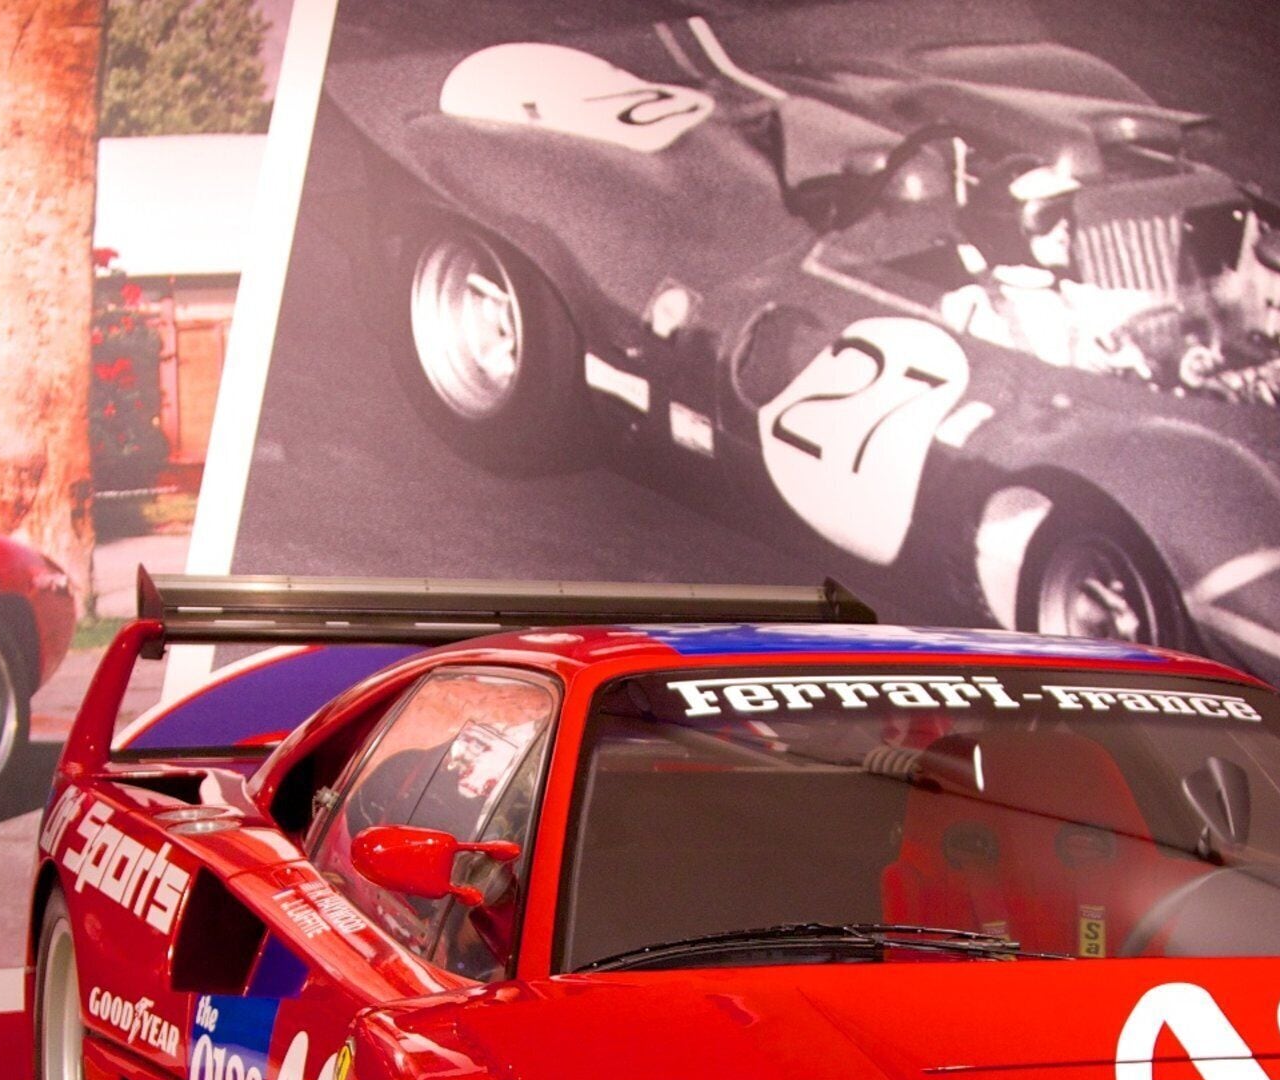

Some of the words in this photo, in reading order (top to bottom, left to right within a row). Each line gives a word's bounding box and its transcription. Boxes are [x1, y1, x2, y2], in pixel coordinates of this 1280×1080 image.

[771, 336, 949, 474] 27
[62, 800, 192, 936] Sports
[196, 994, 219, 1033] the
